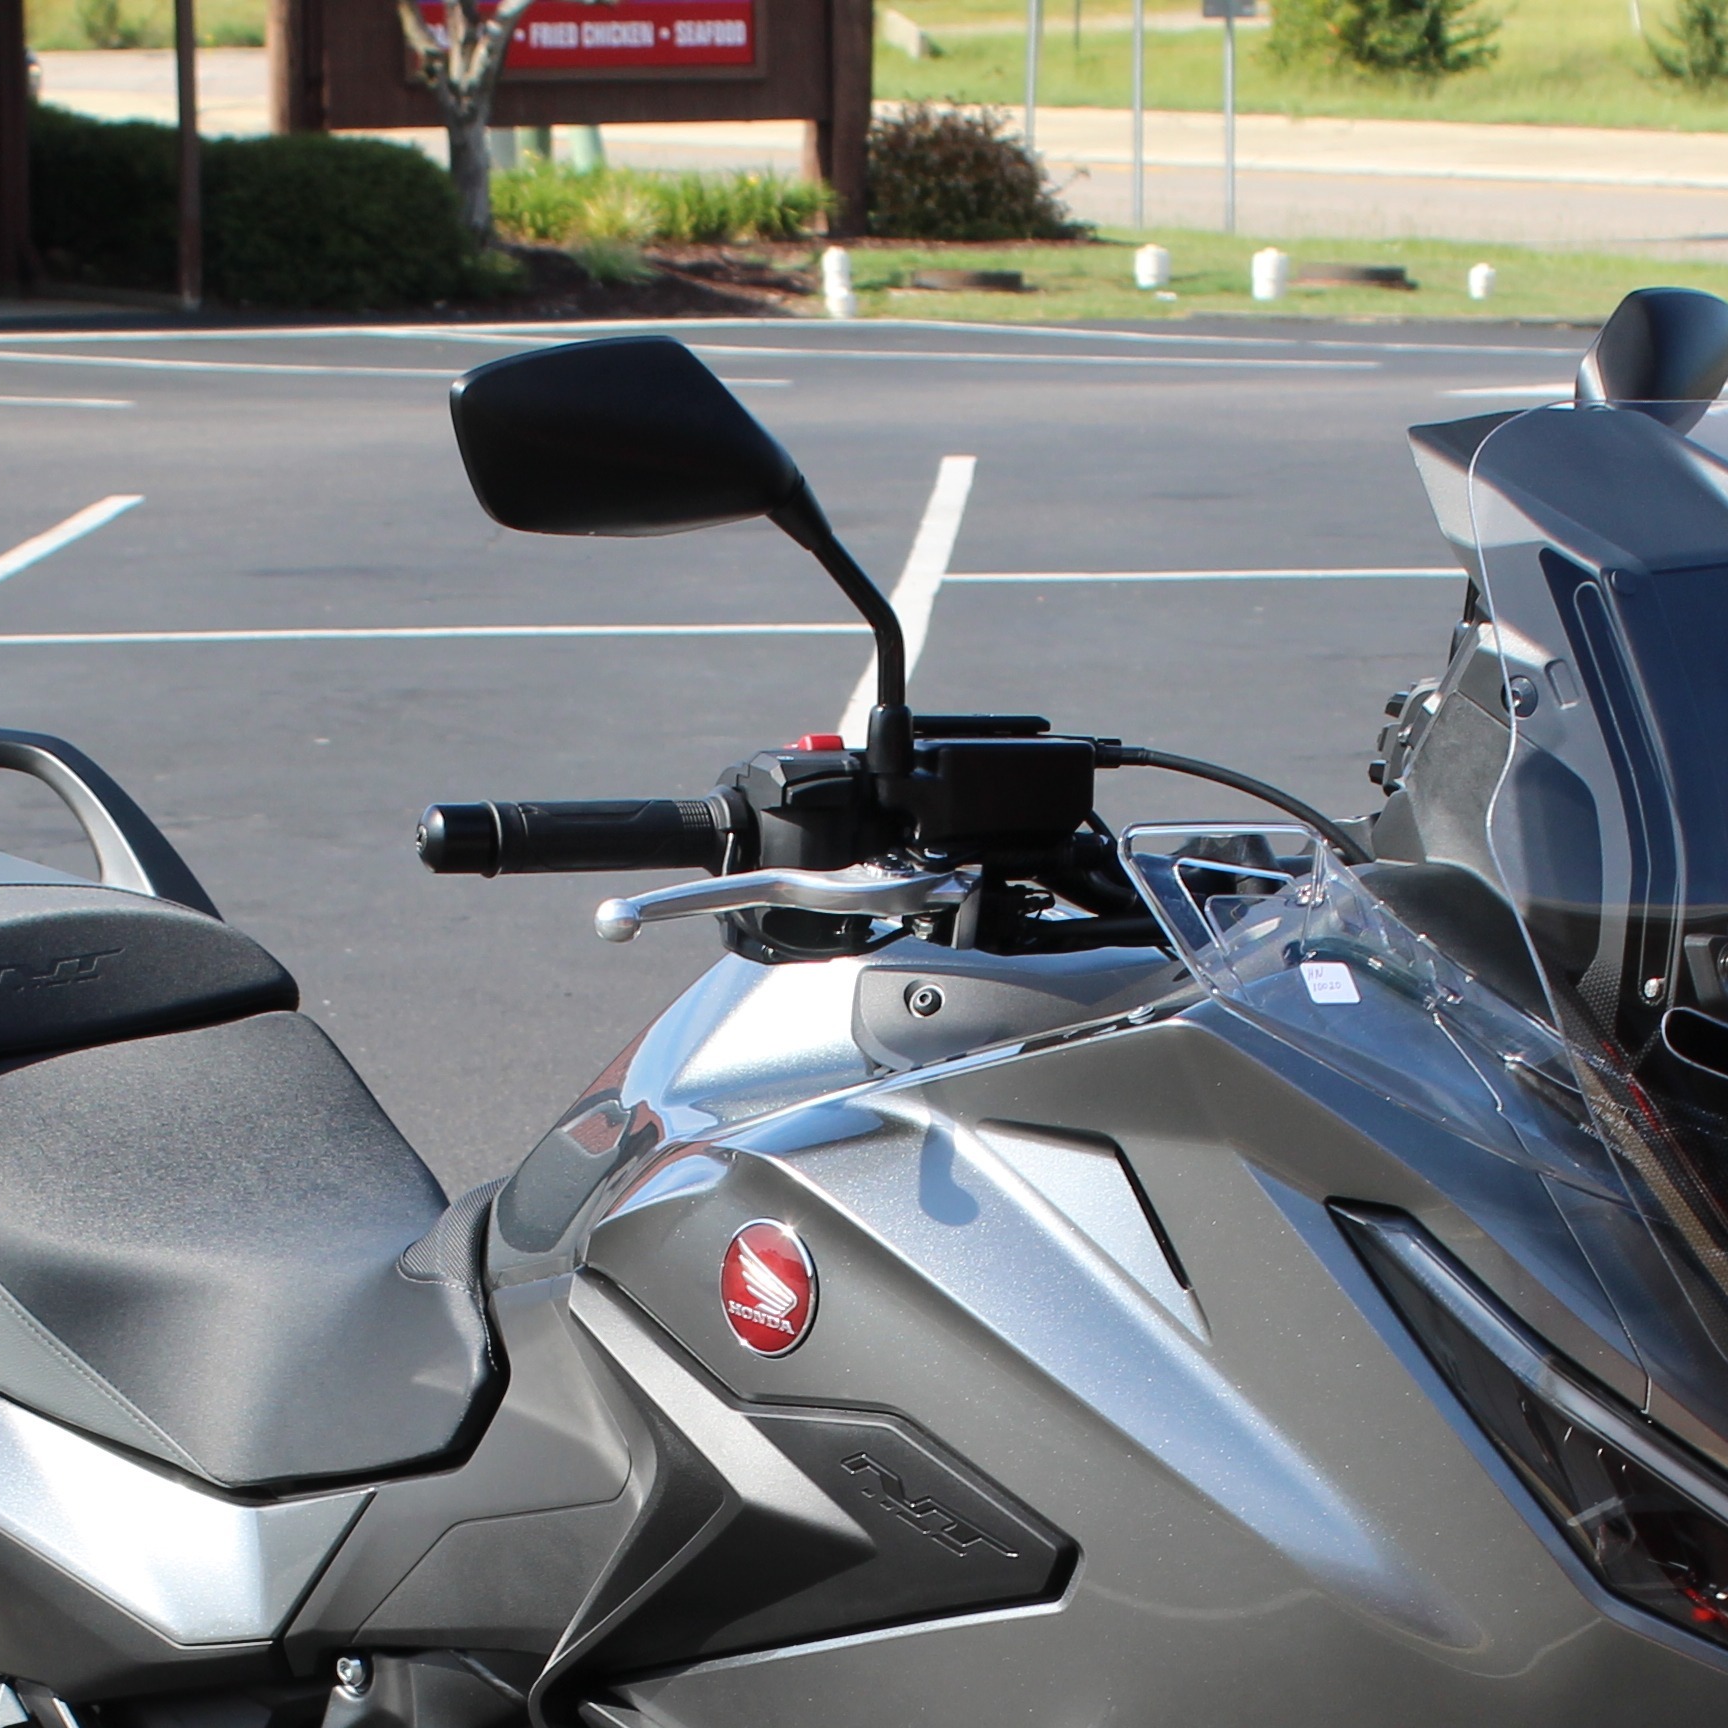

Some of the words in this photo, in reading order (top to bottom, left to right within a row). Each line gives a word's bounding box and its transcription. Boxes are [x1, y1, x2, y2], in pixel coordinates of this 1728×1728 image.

[528, 22, 578, 48] FRIED
[581, 22, 655, 48] CHICKEN
[673, 20, 747, 47] SEAFOOD
[728, 1300, 796, 1335] HONDA
